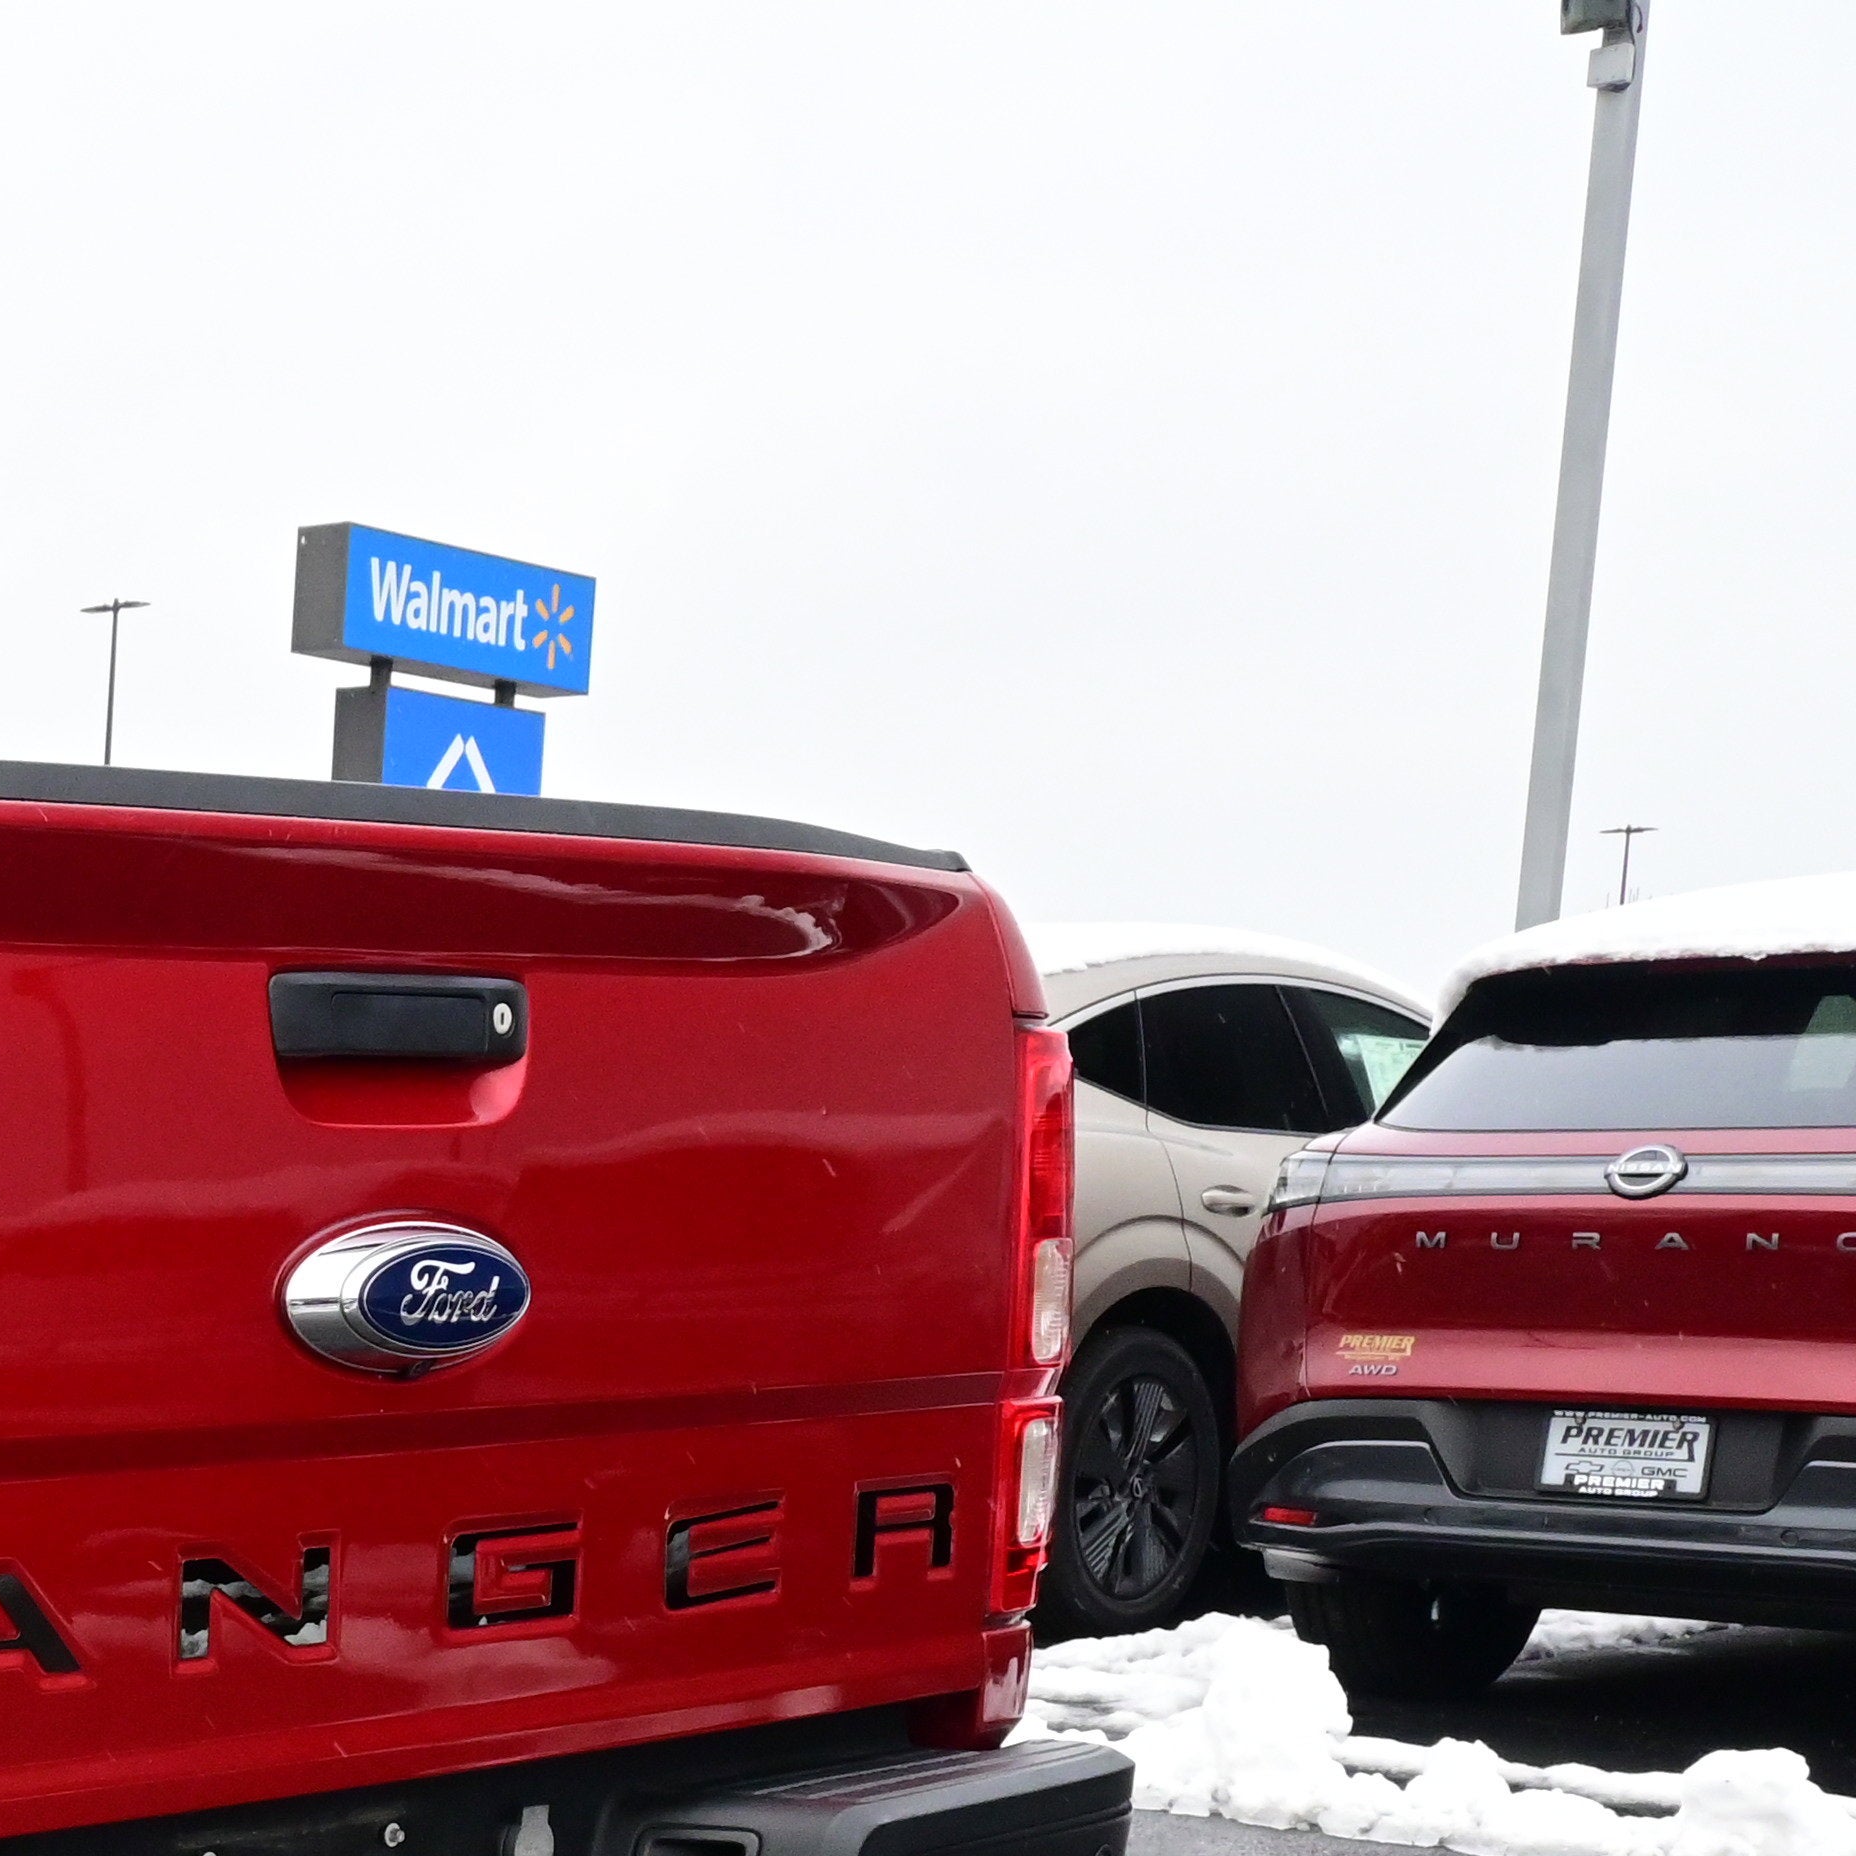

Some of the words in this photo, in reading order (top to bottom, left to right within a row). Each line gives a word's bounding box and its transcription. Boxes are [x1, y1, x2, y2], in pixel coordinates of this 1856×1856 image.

[370, 556, 528, 651] Walmart
[1607, 1162, 1682, 1174] NISSAN
[400, 1259, 501, 1327] Ford
[1339, 1334, 1415, 1356] PREMIER
[1349, 1364, 1397, 1375] AWD
[1560, 1425, 1701, 1462] PREMIER
[1577, 1447, 1618, 1455] AUTO
[1622, 1449, 1675, 1458] GROUP
[1641, 1466, 1688, 1478] GMC
[1574, 1474, 1666, 1491] PREMIER
[1578, 1486, 1612, 1496] AUTO
[1614, 1487, 1659, 1498] GROUP
